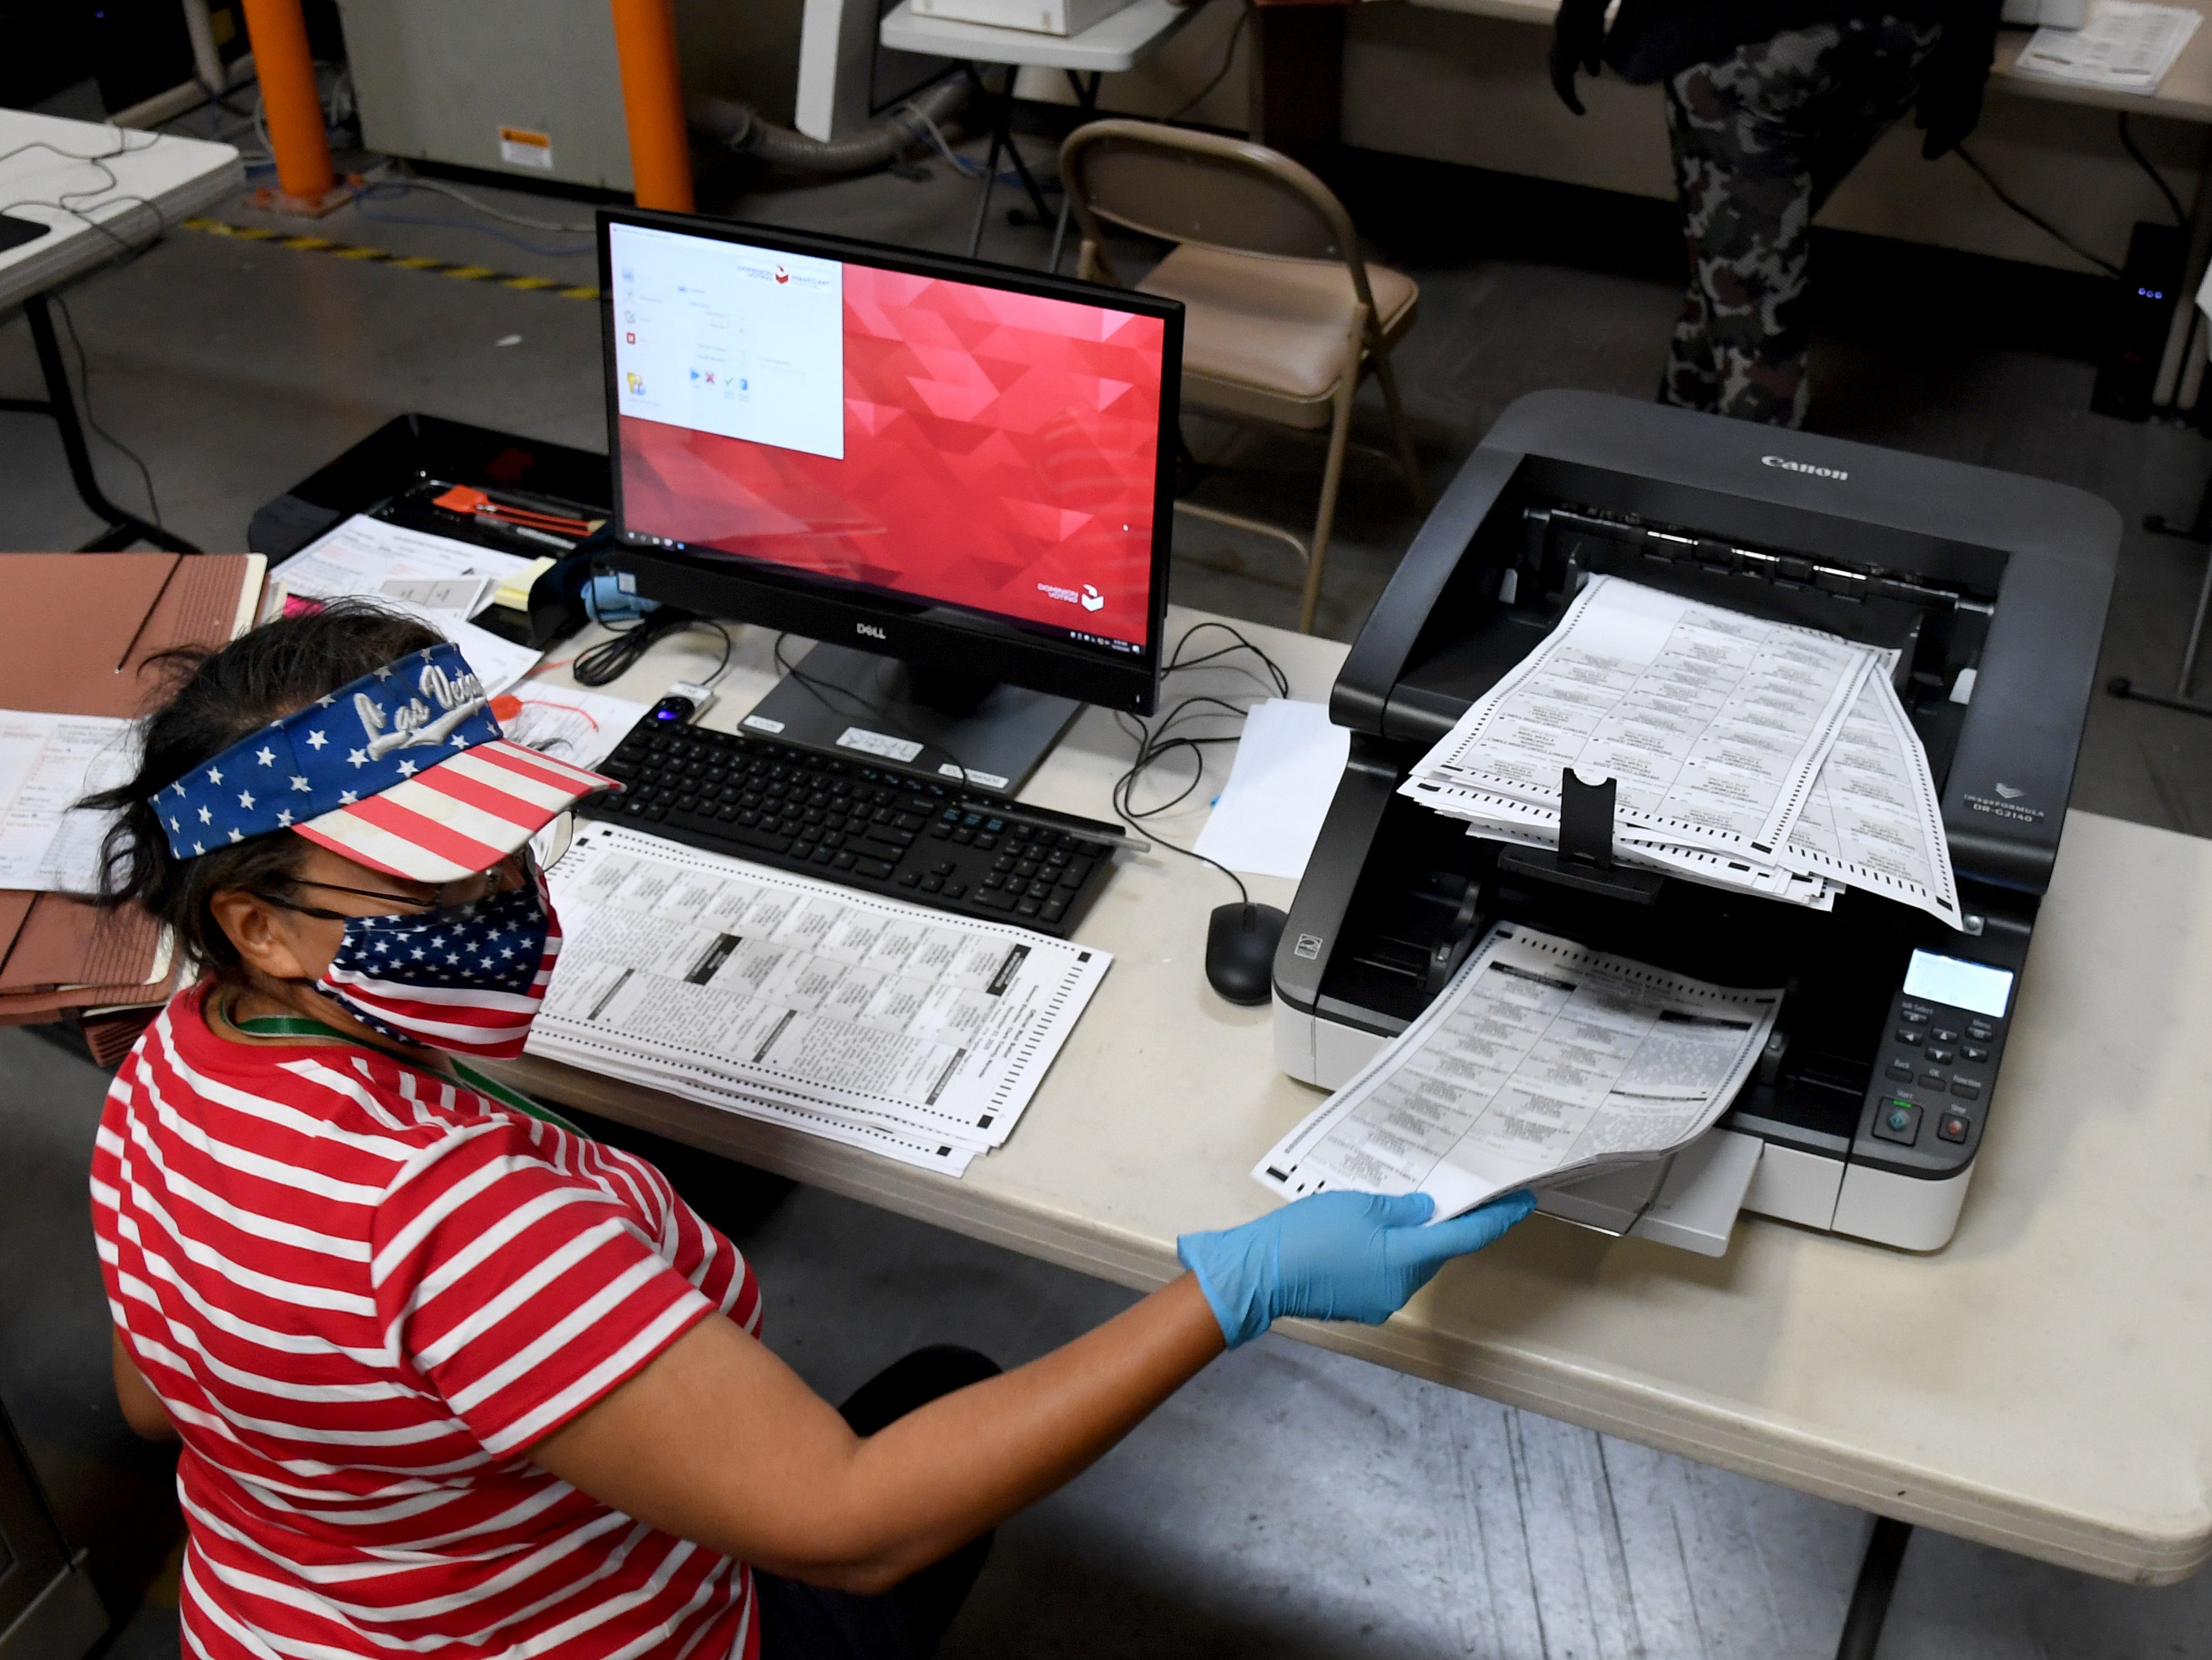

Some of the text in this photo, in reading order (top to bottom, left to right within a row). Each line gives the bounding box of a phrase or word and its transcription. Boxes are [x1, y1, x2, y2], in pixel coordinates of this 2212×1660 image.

[1761, 456, 1848, 481] Canon
[857, 623, 886, 640] DELL
[354, 665, 486, 746] Las Veg
[1972, 803, 2034, 823] DR-G2140
[1003, 1008, 1037, 1059] Official Mail Ballot
[1952, 1074, 1982, 1088] Function
